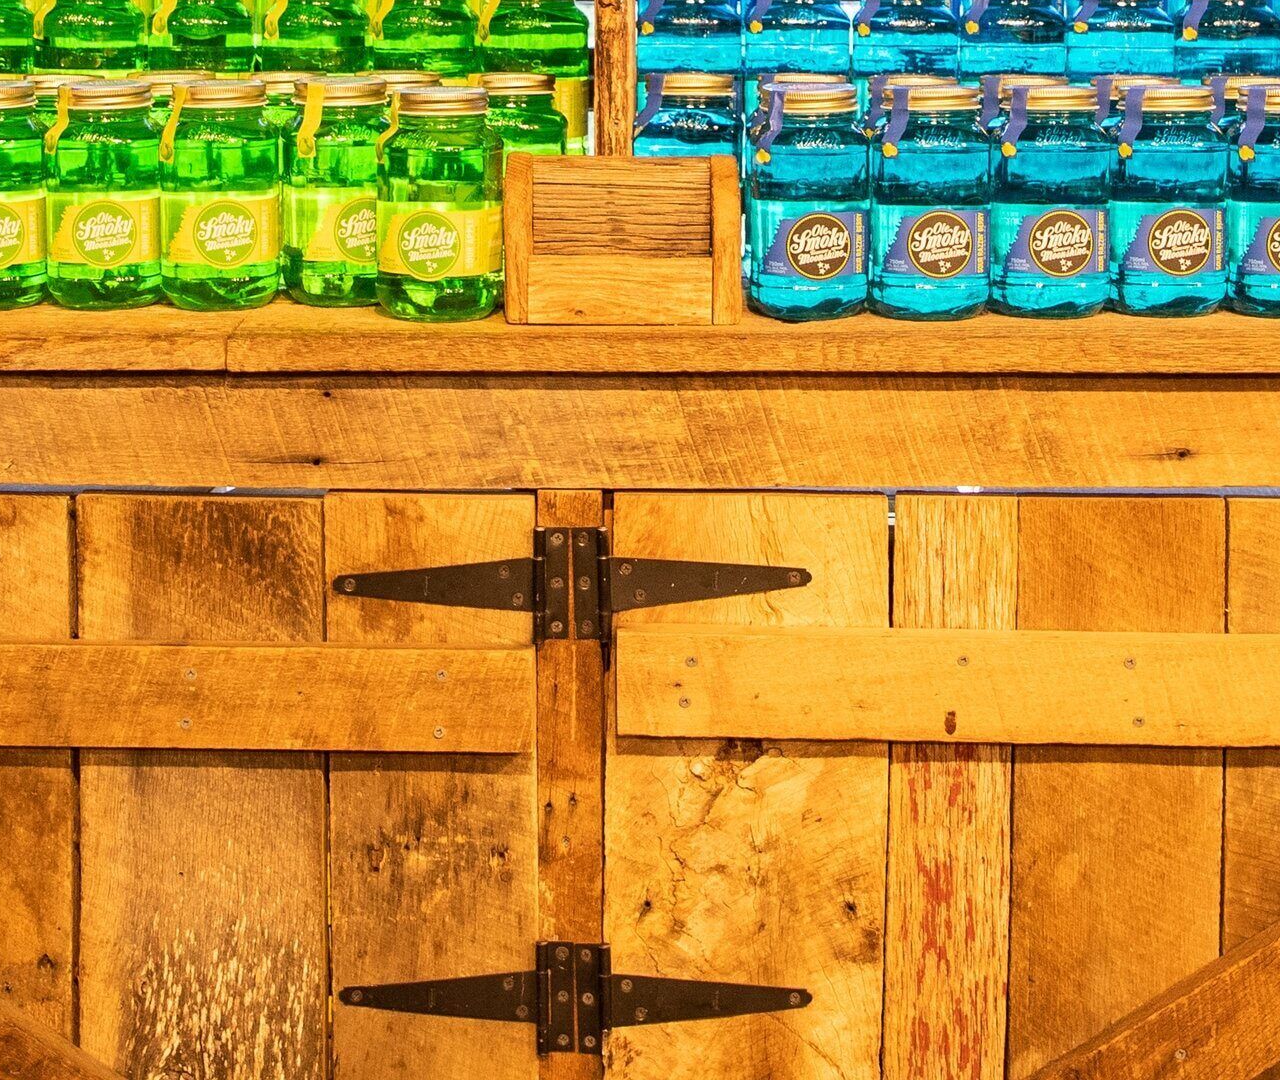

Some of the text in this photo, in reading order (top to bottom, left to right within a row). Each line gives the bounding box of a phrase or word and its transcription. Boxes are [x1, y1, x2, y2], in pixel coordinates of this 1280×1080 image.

[96, 212, 116, 224] Ole
[217, 212, 237, 224] Ole
[78, 216, 135, 240] Smoky
[199, 216, 256, 240] Smoky
[338, 214, 376, 238] Smo
[420, 223, 439, 235] Ole
[812, 224, 832, 237] Ole
[932, 223, 954, 236] Ole
[1054, 221, 1074, 234] Ole
[1173, 221, 1193, 234] Ole
[401, 226, 457, 251] Smoky
[791, 227, 849, 254] Smoky
[911, 226, 971, 253] Smoky
[1033, 224, 1091, 251] Smoky
[1152, 224, 1210, 250] Smoky
[85, 238, 133, 251] Moonshine
[206, 238, 254, 251] Moonshine
[408, 249, 455, 263] Moonshine
[798, 250, 847, 265] Moonshine
[919, 249, 968, 264] Moonshine
[1040, 247, 1089, 262] Moonshine
[1159, 247, 1208, 261] Moonshine
